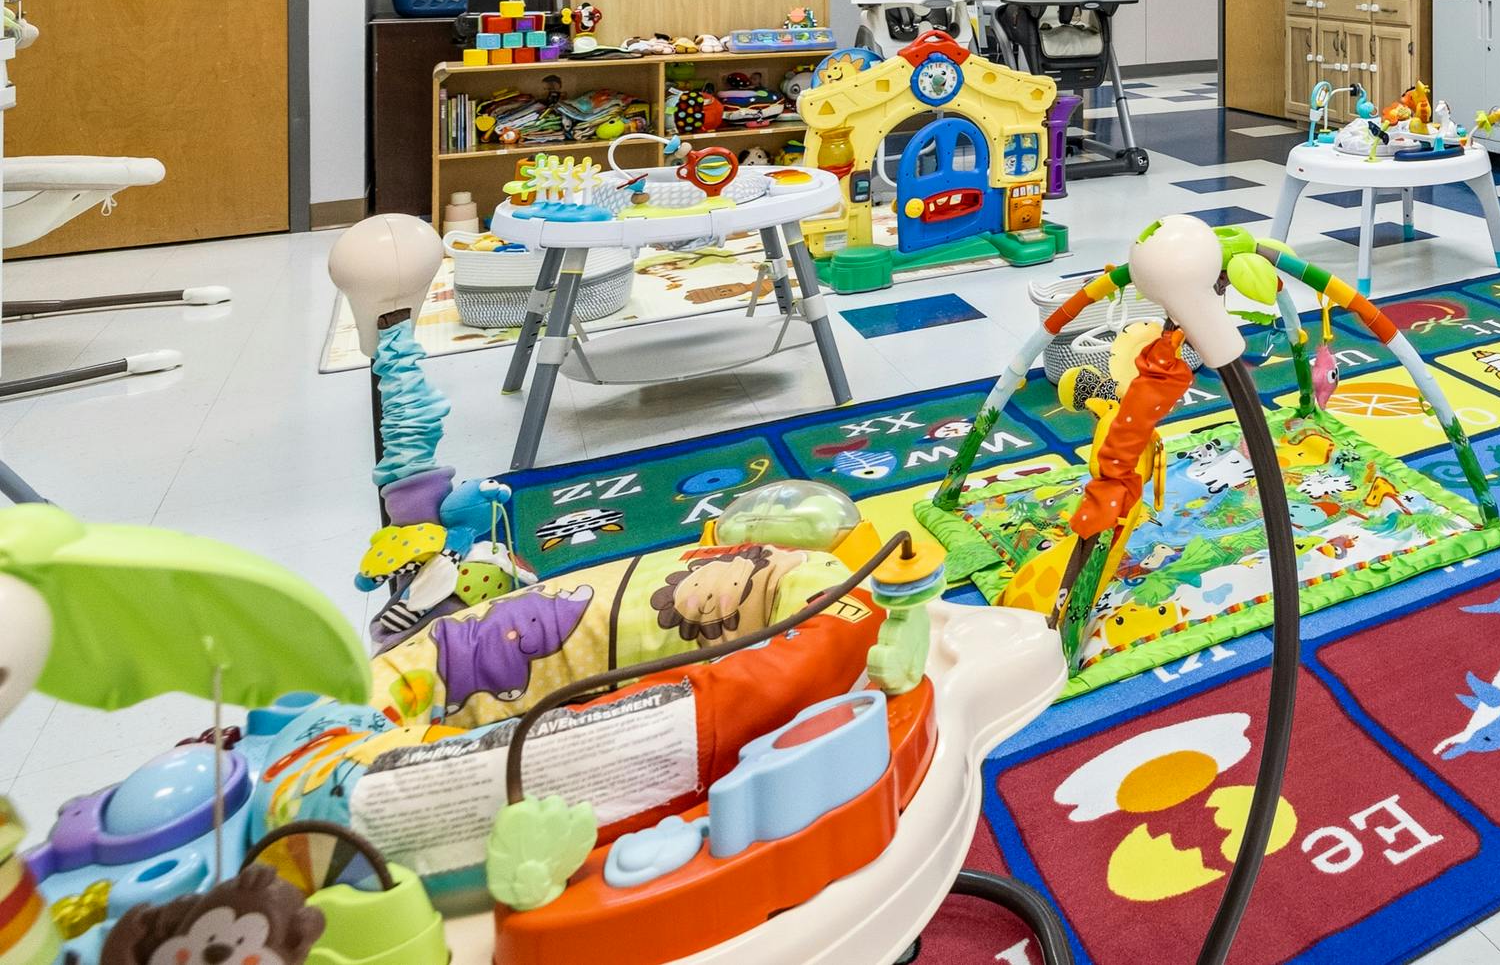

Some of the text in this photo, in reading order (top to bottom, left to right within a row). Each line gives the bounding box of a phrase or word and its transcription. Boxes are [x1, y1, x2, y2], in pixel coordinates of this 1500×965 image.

[840, 411, 926, 438] Xx
[553, 473, 642, 505] Zz
[537, 693, 663, 736] AVERTISSEMENT
[1301, 794, 1444, 874] Ee
